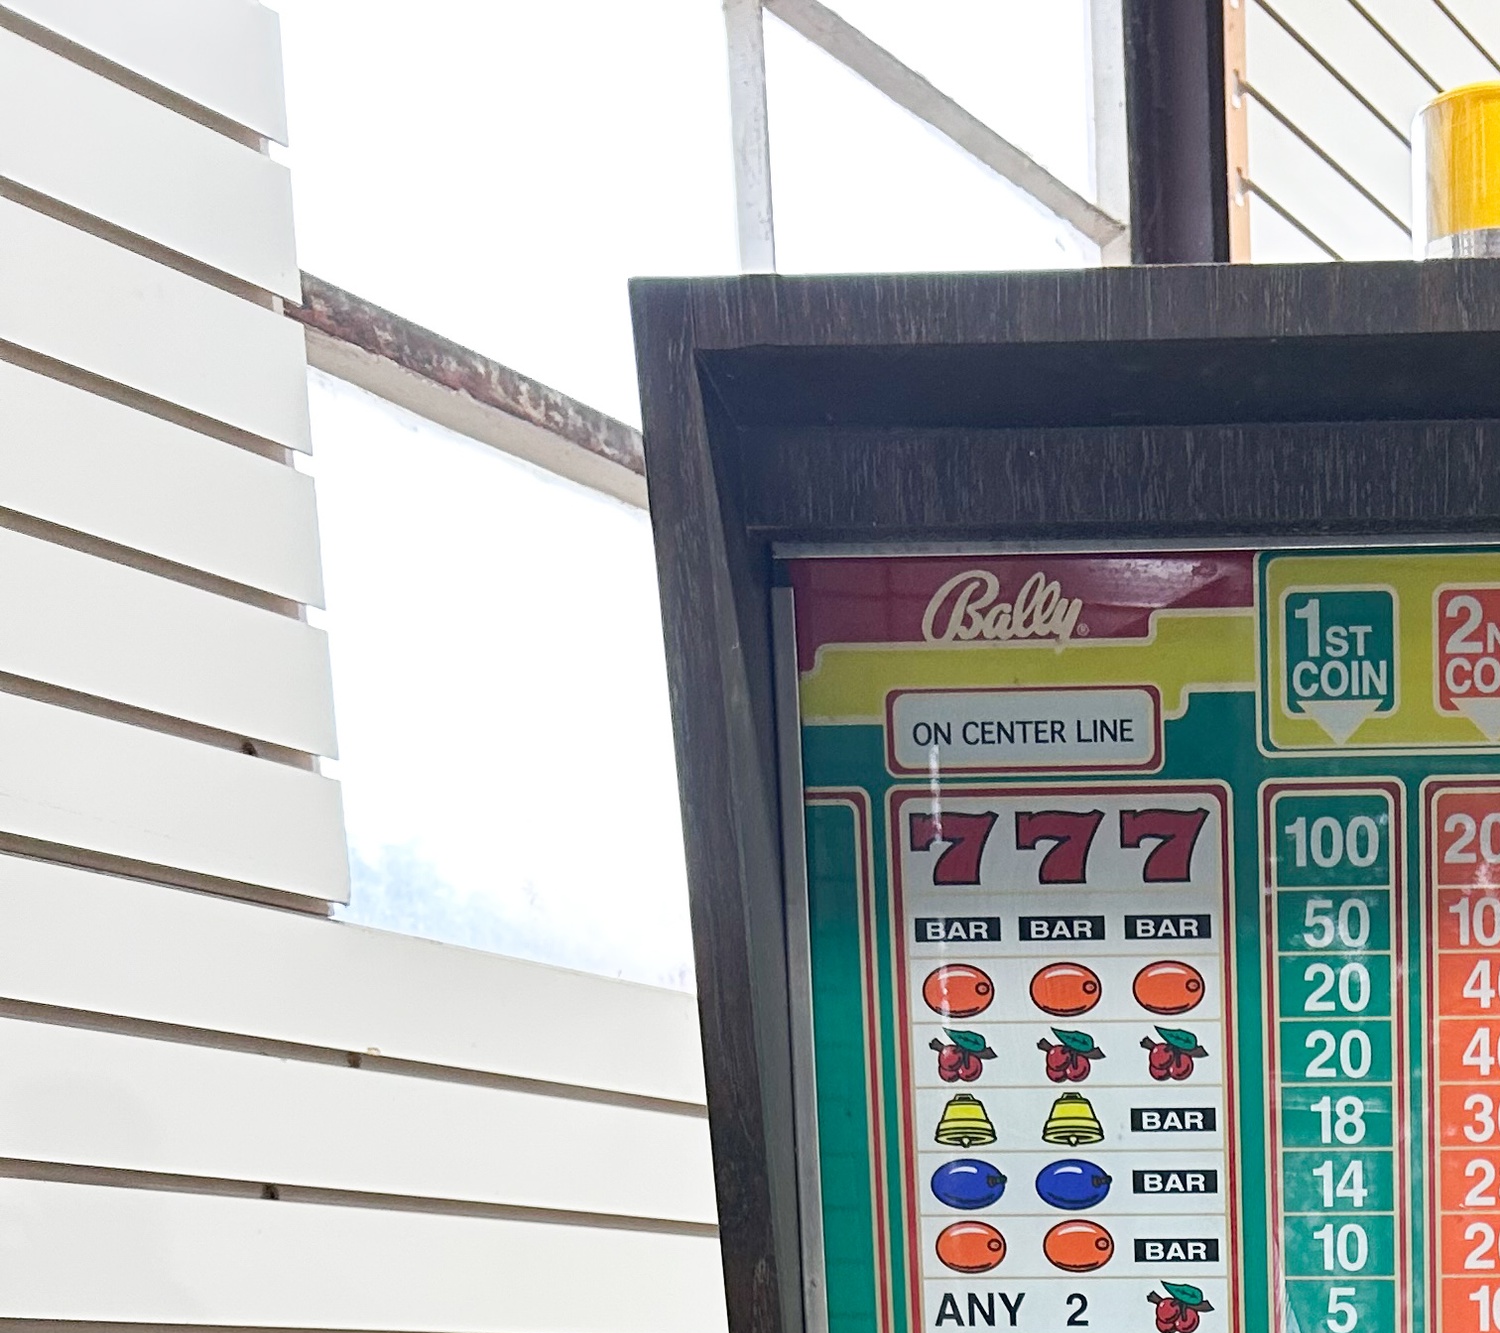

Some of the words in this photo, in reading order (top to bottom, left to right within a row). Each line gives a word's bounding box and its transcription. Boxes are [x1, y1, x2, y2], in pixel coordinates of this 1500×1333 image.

[922, 570, 1083, 648] Bally
[1295, 599, 1372, 658] 1ST
[1292, 659, 1388, 697] COIN
[912, 722, 952, 747] ON
[962, 720, 1066, 745] CENTER
[1076, 719, 1133, 743] LINE
[910, 811, 998, 885] 7
[1015, 810, 1105, 885] 7
[1120, 808, 1209, 882] 7
[1284, 816, 1379, 867] 100
[925, 920, 989, 939] BAR
[1030, 919, 1093, 938] BAR
[1135, 917, 1200, 936] BAR
[1303, 898, 1370, 948] 50
[1303, 964, 1371, 1013] 20
[1304, 1029, 1372, 1078] 20
[1141, 1110, 1204, 1130] BAR
[1310, 1096, 1366, 1145] 18
[1142, 1172, 1206, 1192] BAR
[1312, 1160, 1368, 1208] 14
[1144, 1240, 1208, 1260] BAR
[1312, 1223, 1369, 1271] 10
[934, 1293, 1026, 1326] ANY
[1066, 1293, 1089, 1326] 2
